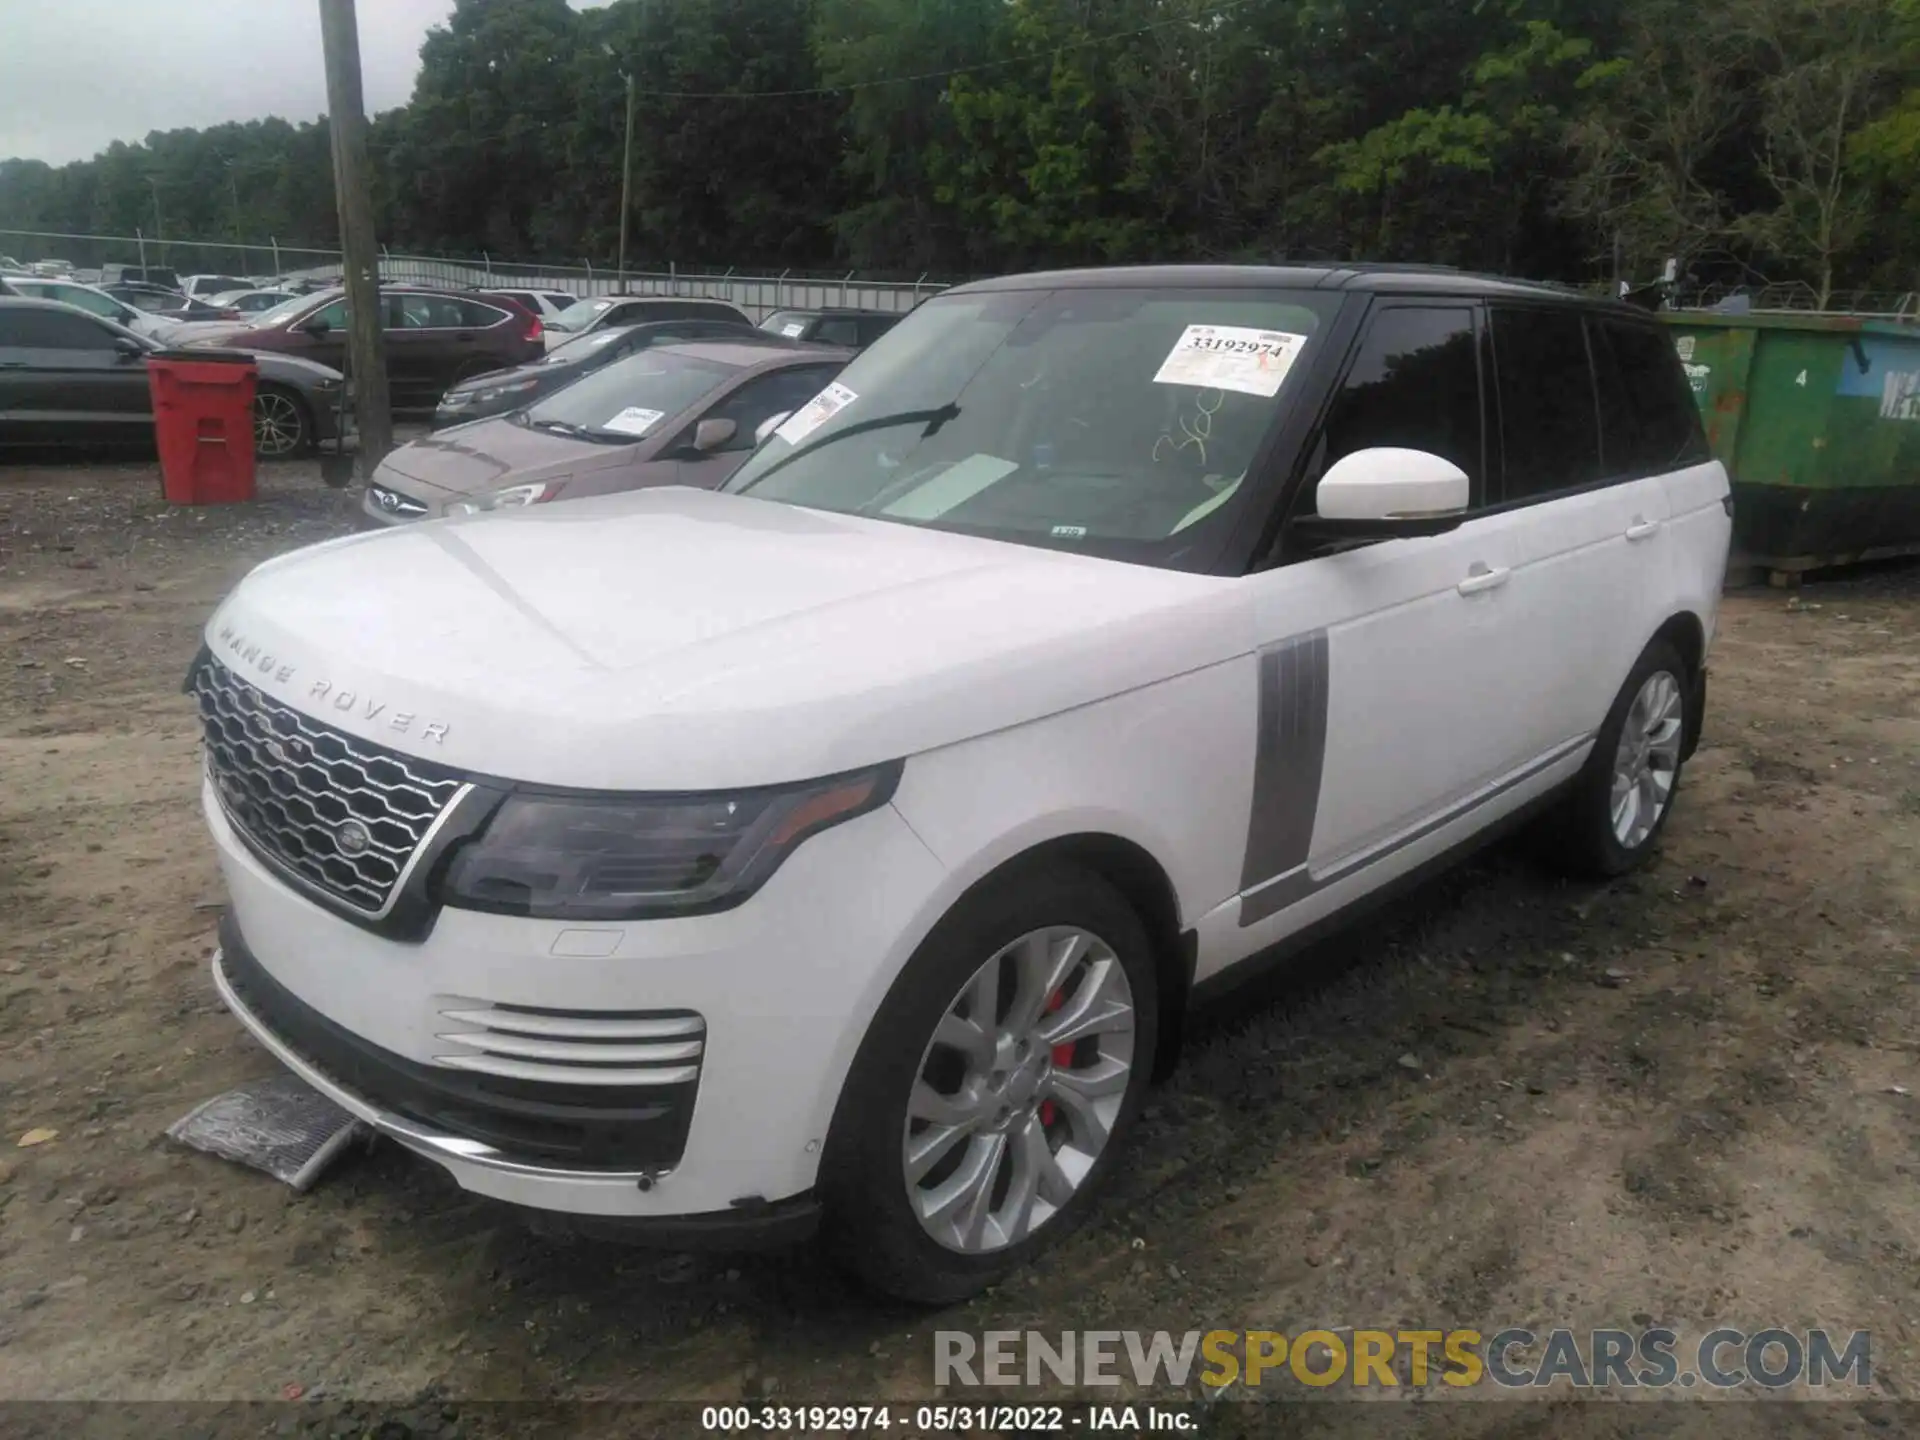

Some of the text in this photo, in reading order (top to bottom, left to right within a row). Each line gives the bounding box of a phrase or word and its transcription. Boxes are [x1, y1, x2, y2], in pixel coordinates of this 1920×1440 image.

[1187, 336, 1284, 358] 33192974
[1795, 368, 1808, 388] 4
[219, 626, 451, 745] RANGE ROVER
